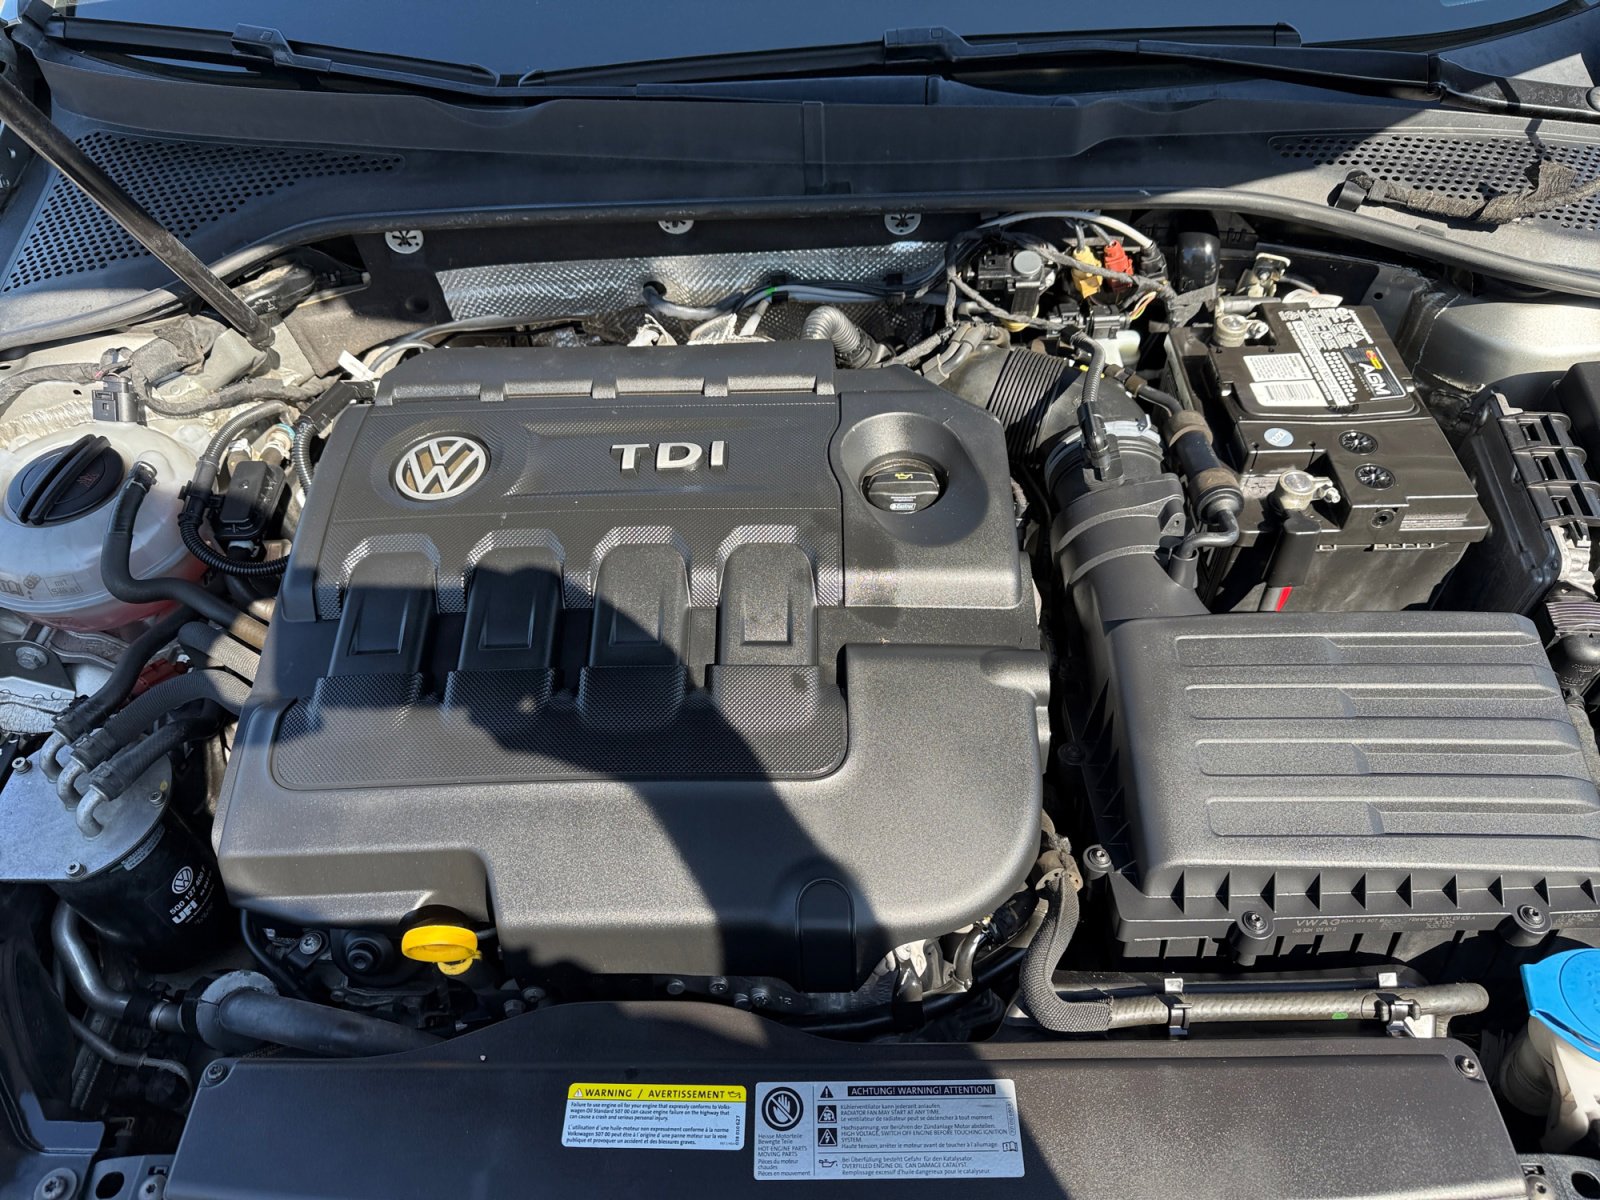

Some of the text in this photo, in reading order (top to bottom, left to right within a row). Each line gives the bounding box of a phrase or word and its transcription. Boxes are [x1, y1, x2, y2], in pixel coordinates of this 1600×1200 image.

[1358, 362, 1391, 394] AGM
[395, 436, 487, 500] VW
[611, 440, 727, 471] TDI
[185, 886, 196, 900] 127
[195, 871, 204, 887] 400
[171, 900, 198, 924] UFI
[585, 1089, 725, 1099] WARNING / AVERTISSEMENT
[851, 1085, 993, 1096] ACHTUNG! WARNING! ATTENTION!
[601, 1102, 617, 1110] engine
